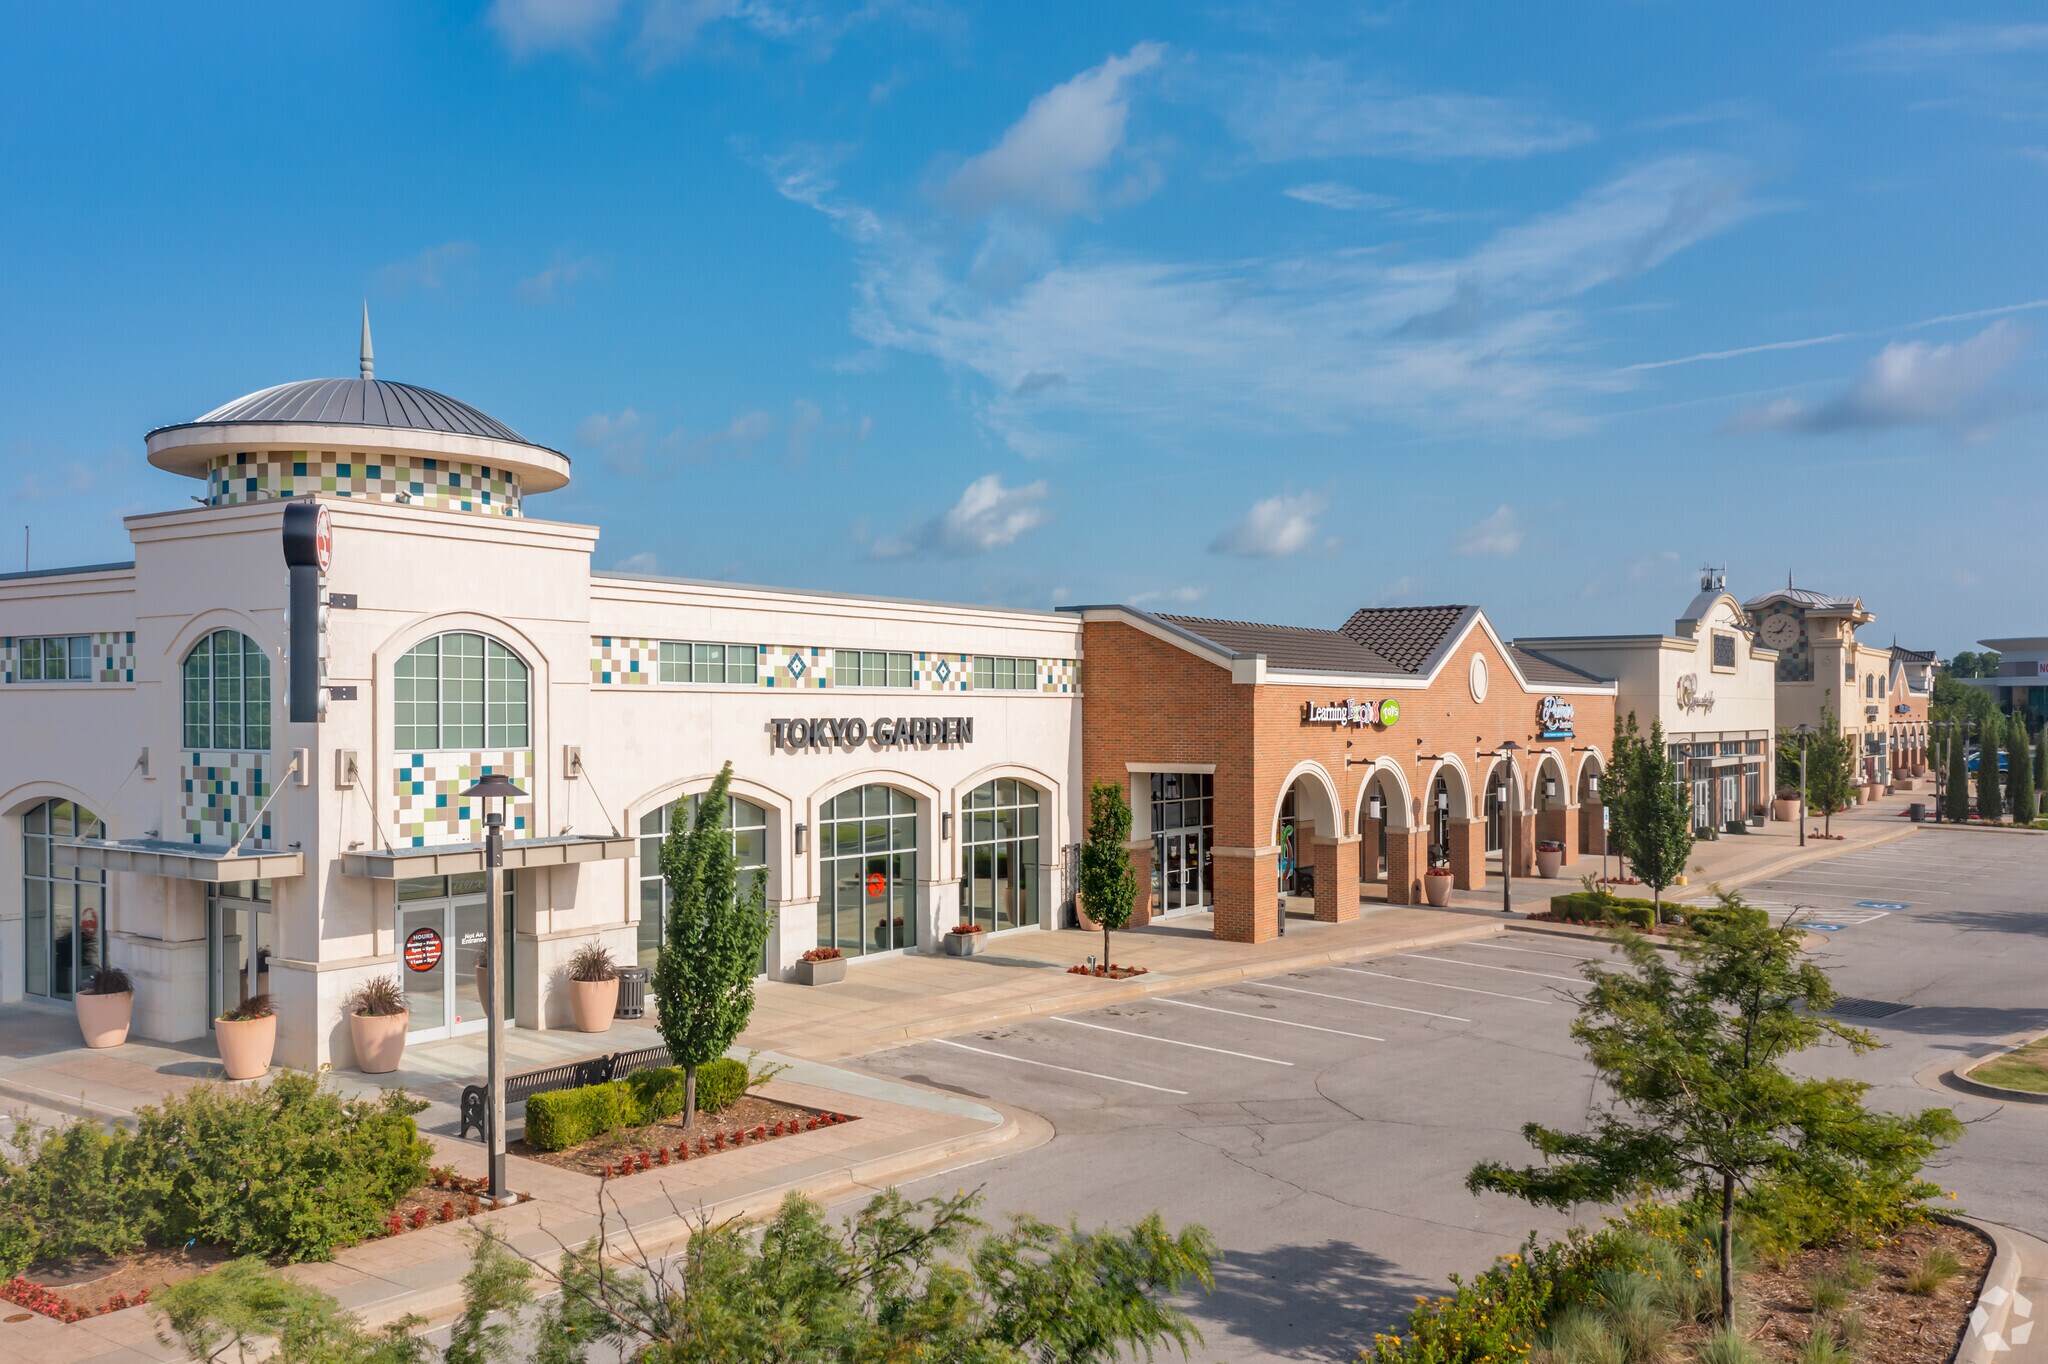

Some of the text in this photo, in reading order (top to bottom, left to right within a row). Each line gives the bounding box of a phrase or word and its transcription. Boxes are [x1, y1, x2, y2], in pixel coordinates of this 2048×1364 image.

[1309, 701, 1347, 726] Learning
[771, 717, 973, 748] TOKYO GARDEN
